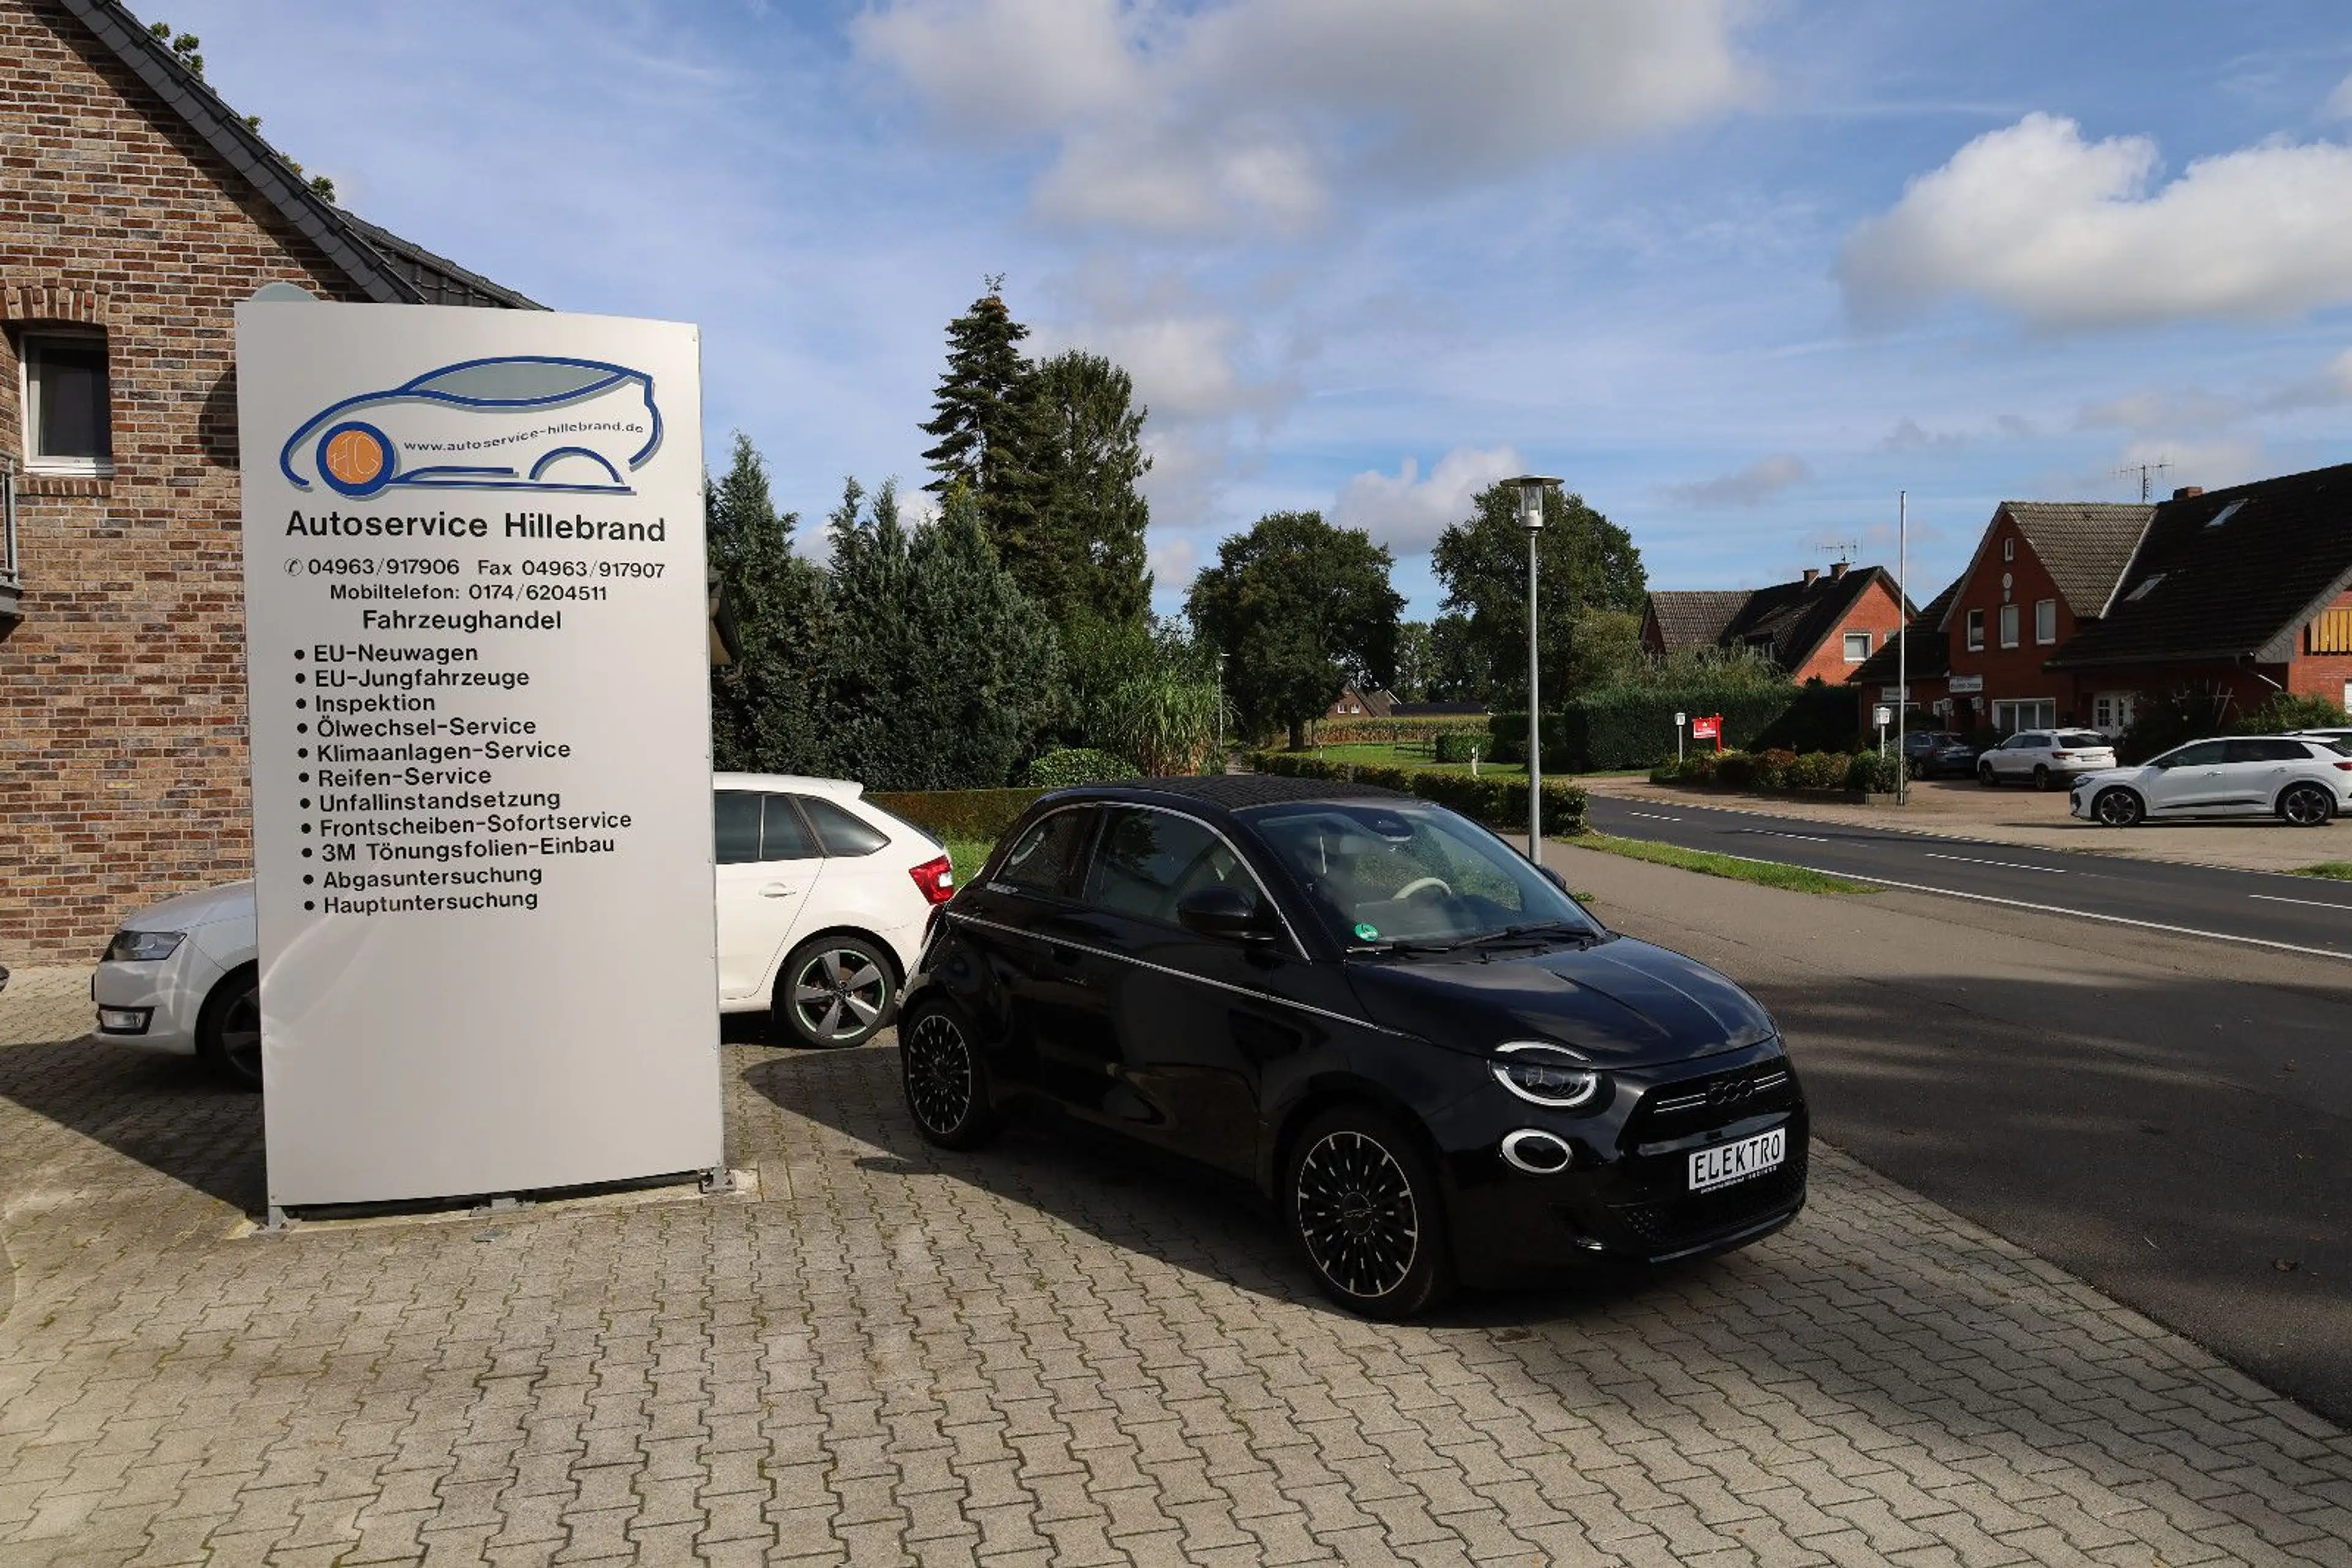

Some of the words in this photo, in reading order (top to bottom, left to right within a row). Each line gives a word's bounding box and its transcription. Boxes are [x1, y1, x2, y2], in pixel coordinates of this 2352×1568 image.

[403, 421, 644, 451] www.autoservice-hillebrand.de
[285, 510, 488, 538] Autoservice
[505, 512, 665, 542] Hillebrand
[307, 557, 460, 576] 04963/917906
[478, 559, 513, 576] Fax
[521, 559, 665, 579] 04963/917907
[330, 583, 459, 601] Mobiltelefon:
[468, 582, 606, 602] 0174/6204511
[363, 609, 561, 634] Fahrzeughandel
[314, 643, 478, 665] EU-Neuwagen
[315, 668, 530, 691] EU-Jungfahrzeuge
[315, 693, 435, 716] Inspektion
[317, 714, 536, 738] Ölwechsel-Service
[317, 740, 571, 764] Klimaanlagen-Service
[318, 766, 492, 788] Reifen-Service
[319, 790, 560, 813] Unfallinstandsetzung
[320, 811, 631, 840] Frontscheiben-Sofortservice
[322, 843, 356, 862] 3M
[365, 835, 614, 862] Tönungsfolien-Einbau
[323, 867, 542, 892] Abgasuntersuchung
[324, 891, 538, 917] Hauptuntersuchung
[1695, 1134, 1780, 1184] ELEKTRO
